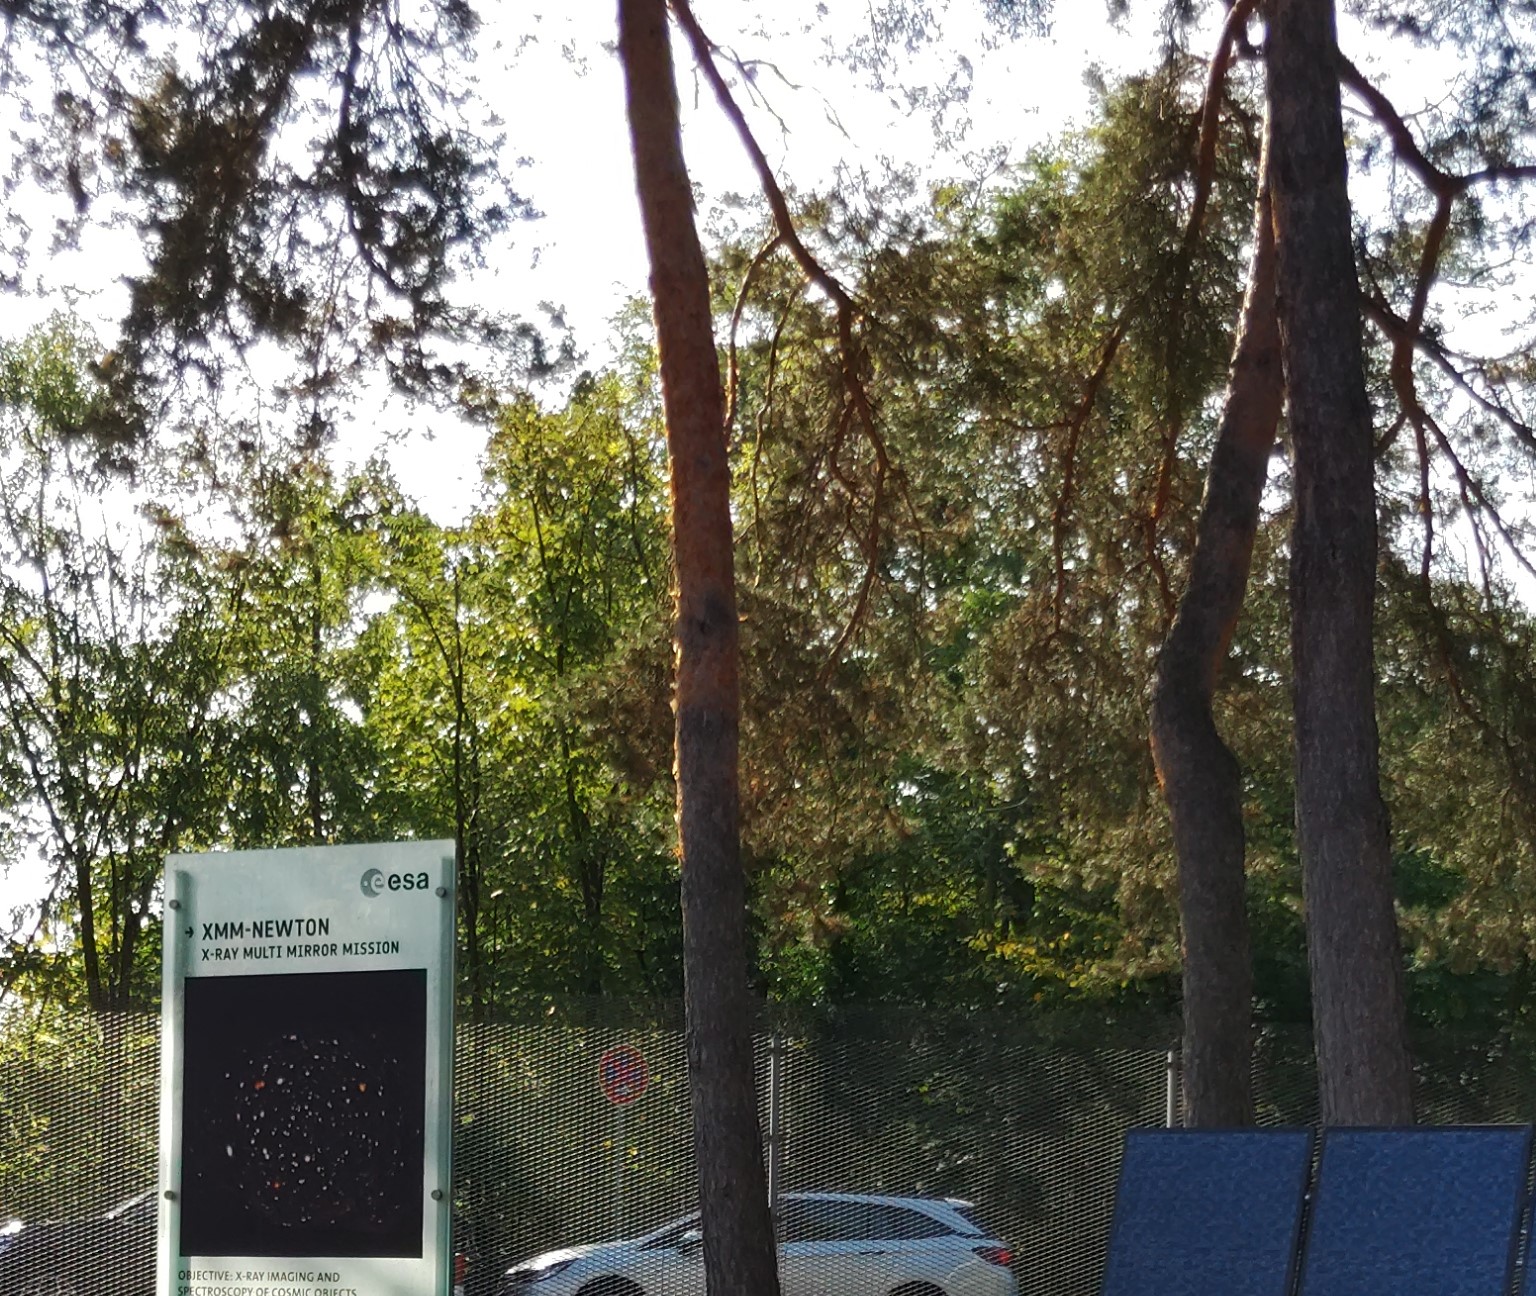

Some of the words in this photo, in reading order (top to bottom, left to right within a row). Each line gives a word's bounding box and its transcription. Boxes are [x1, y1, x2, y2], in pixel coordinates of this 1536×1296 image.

[387, 872, 429, 890] esa
[202, 917, 330, 940] XMM-NEWTON
[201, 947, 239, 961] X-RAY
[243, 945, 282, 960] MULTI
[286, 943, 338, 958] MIRROR
[342, 940, 400, 956] MISSION
[178, 1270, 233, 1281] OBJECTIVE:
[235, 1271, 265, 1281] X-RAY
[268, 1272, 314, 1282] IMAGING
[317, 1272, 340, 1283] AND
